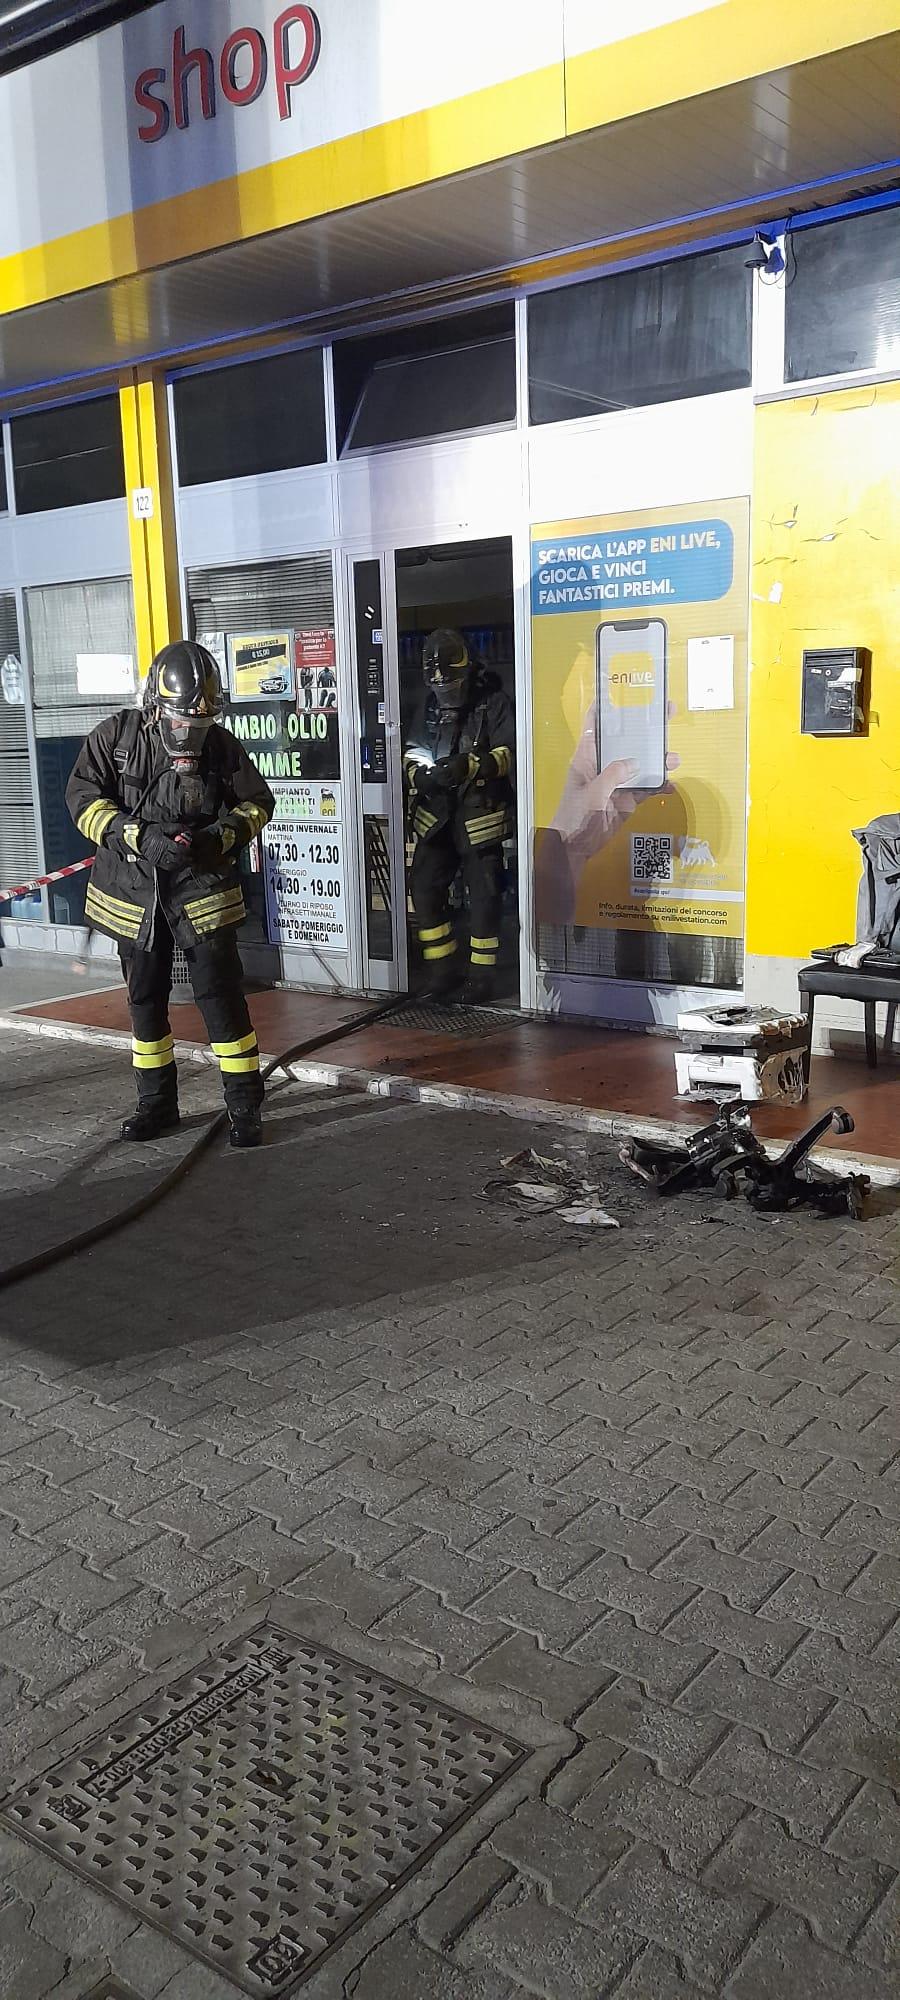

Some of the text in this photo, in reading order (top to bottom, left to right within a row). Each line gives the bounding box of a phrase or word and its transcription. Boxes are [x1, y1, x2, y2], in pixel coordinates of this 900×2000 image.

[134, 3, 322, 143] shop
[136, 495, 150, 512] 122
[538, 530, 721, 565] SCARICA L'APP ENI LIVE,
[538, 560, 647, 585] GIOCA E VINCI
[538, 578, 676, 605] FANTASTICI PREMI.
[216, 713, 328, 740] AMBIO OLIO
[272, 787, 311, 796] IMPIANTO
[321, 805, 336, 817] eni
[267, 823, 338, 834] ORARIO INVERNALE
[268, 843, 298, 862] 07.30
[308, 844, 340, 864] 12.30
[269, 867, 308, 877] POMERIGGIO
[270, 876, 300, 894] 14.30
[310, 879, 341, 898] 19.00
[302, 901, 309, 909] DI
[310, 902, 334, 911] RIPOSO
[642, 902, 679, 915] limitazioni
[680, 907, 692, 915] del
[692, 908, 728, 917] concorso
[273, 918, 344, 934] SABATO POMERIGGIO
[288, 929, 330, 943] E DOMENICA
